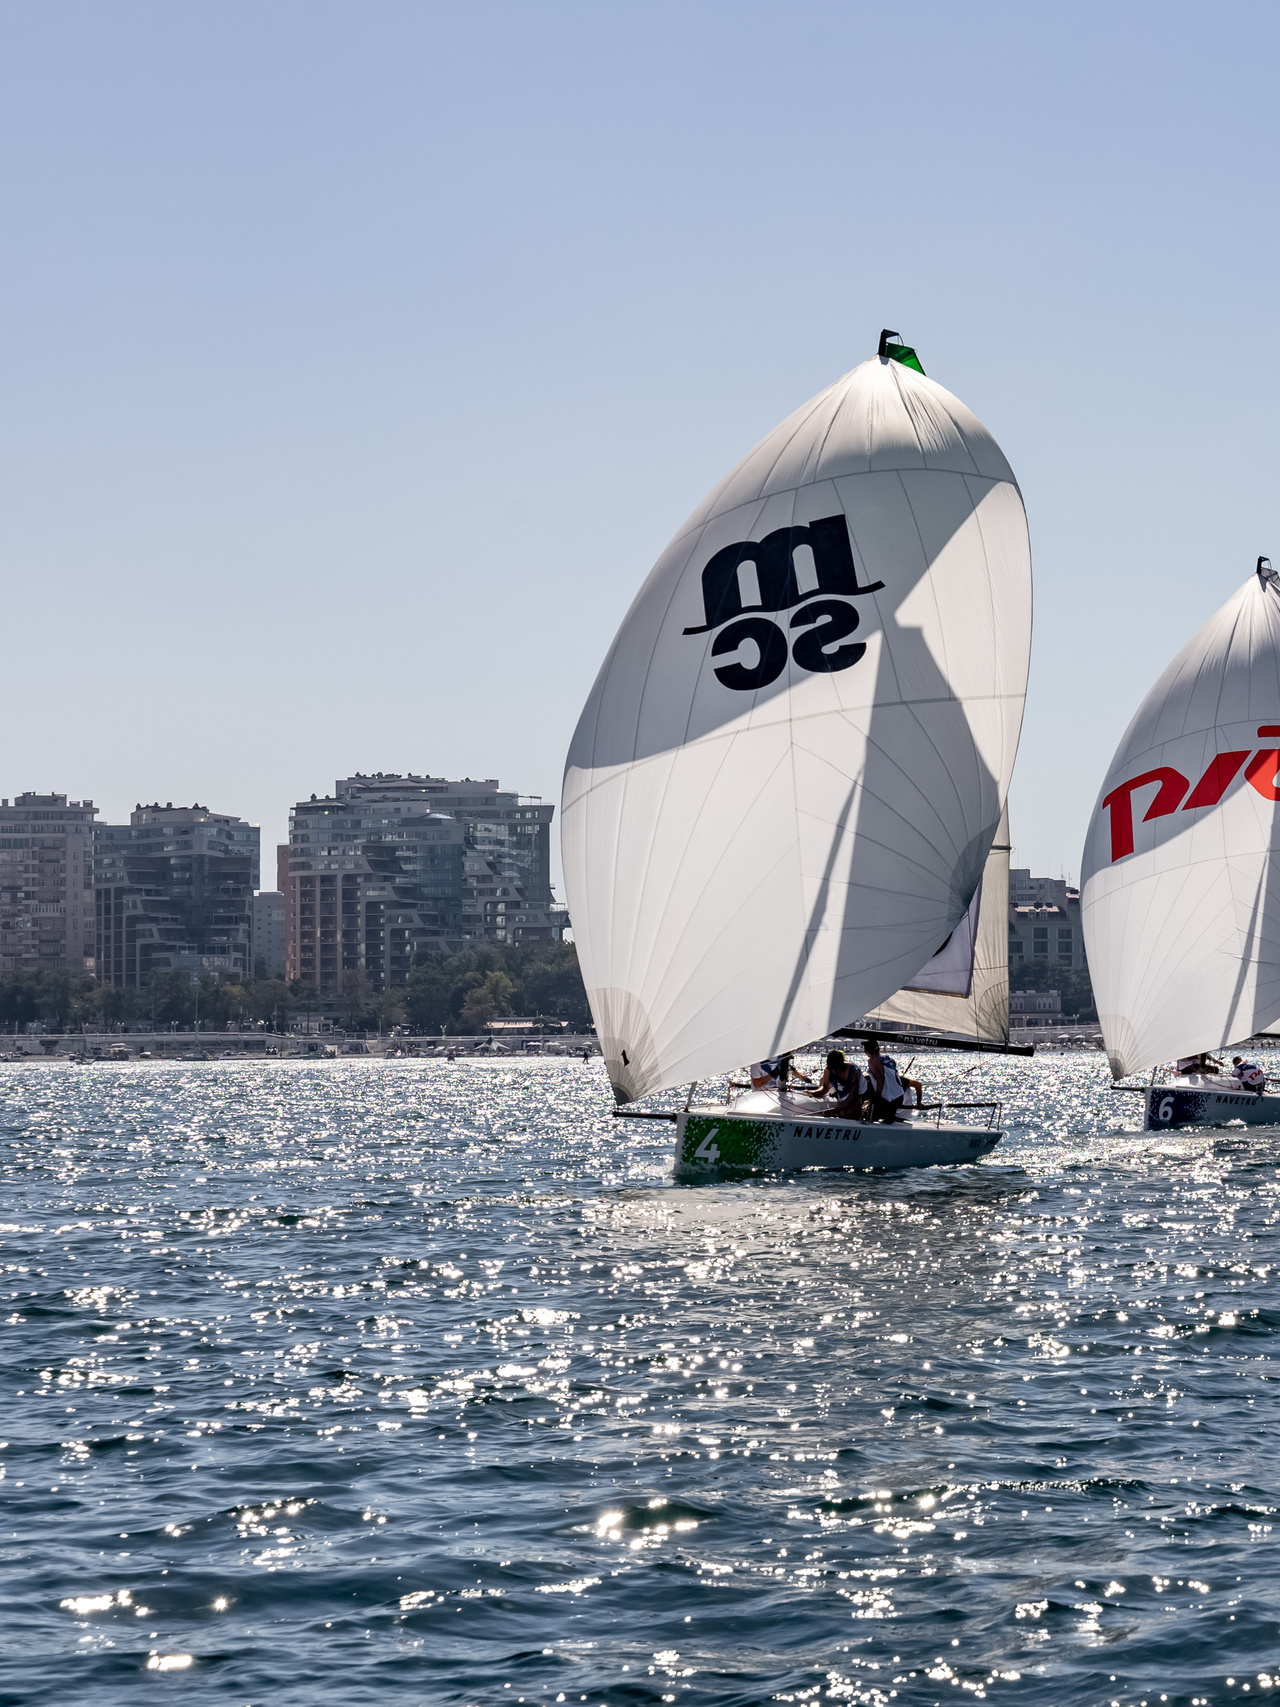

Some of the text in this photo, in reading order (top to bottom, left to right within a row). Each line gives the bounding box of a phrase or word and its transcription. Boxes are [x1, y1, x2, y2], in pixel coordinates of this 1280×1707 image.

[1158, 1096, 1174, 1122] 6
[1216, 1095, 1257, 1106] NAVETRU
[793, 1126, 862, 1141] NAVETRU
[694, 1128, 721, 1164] 4
